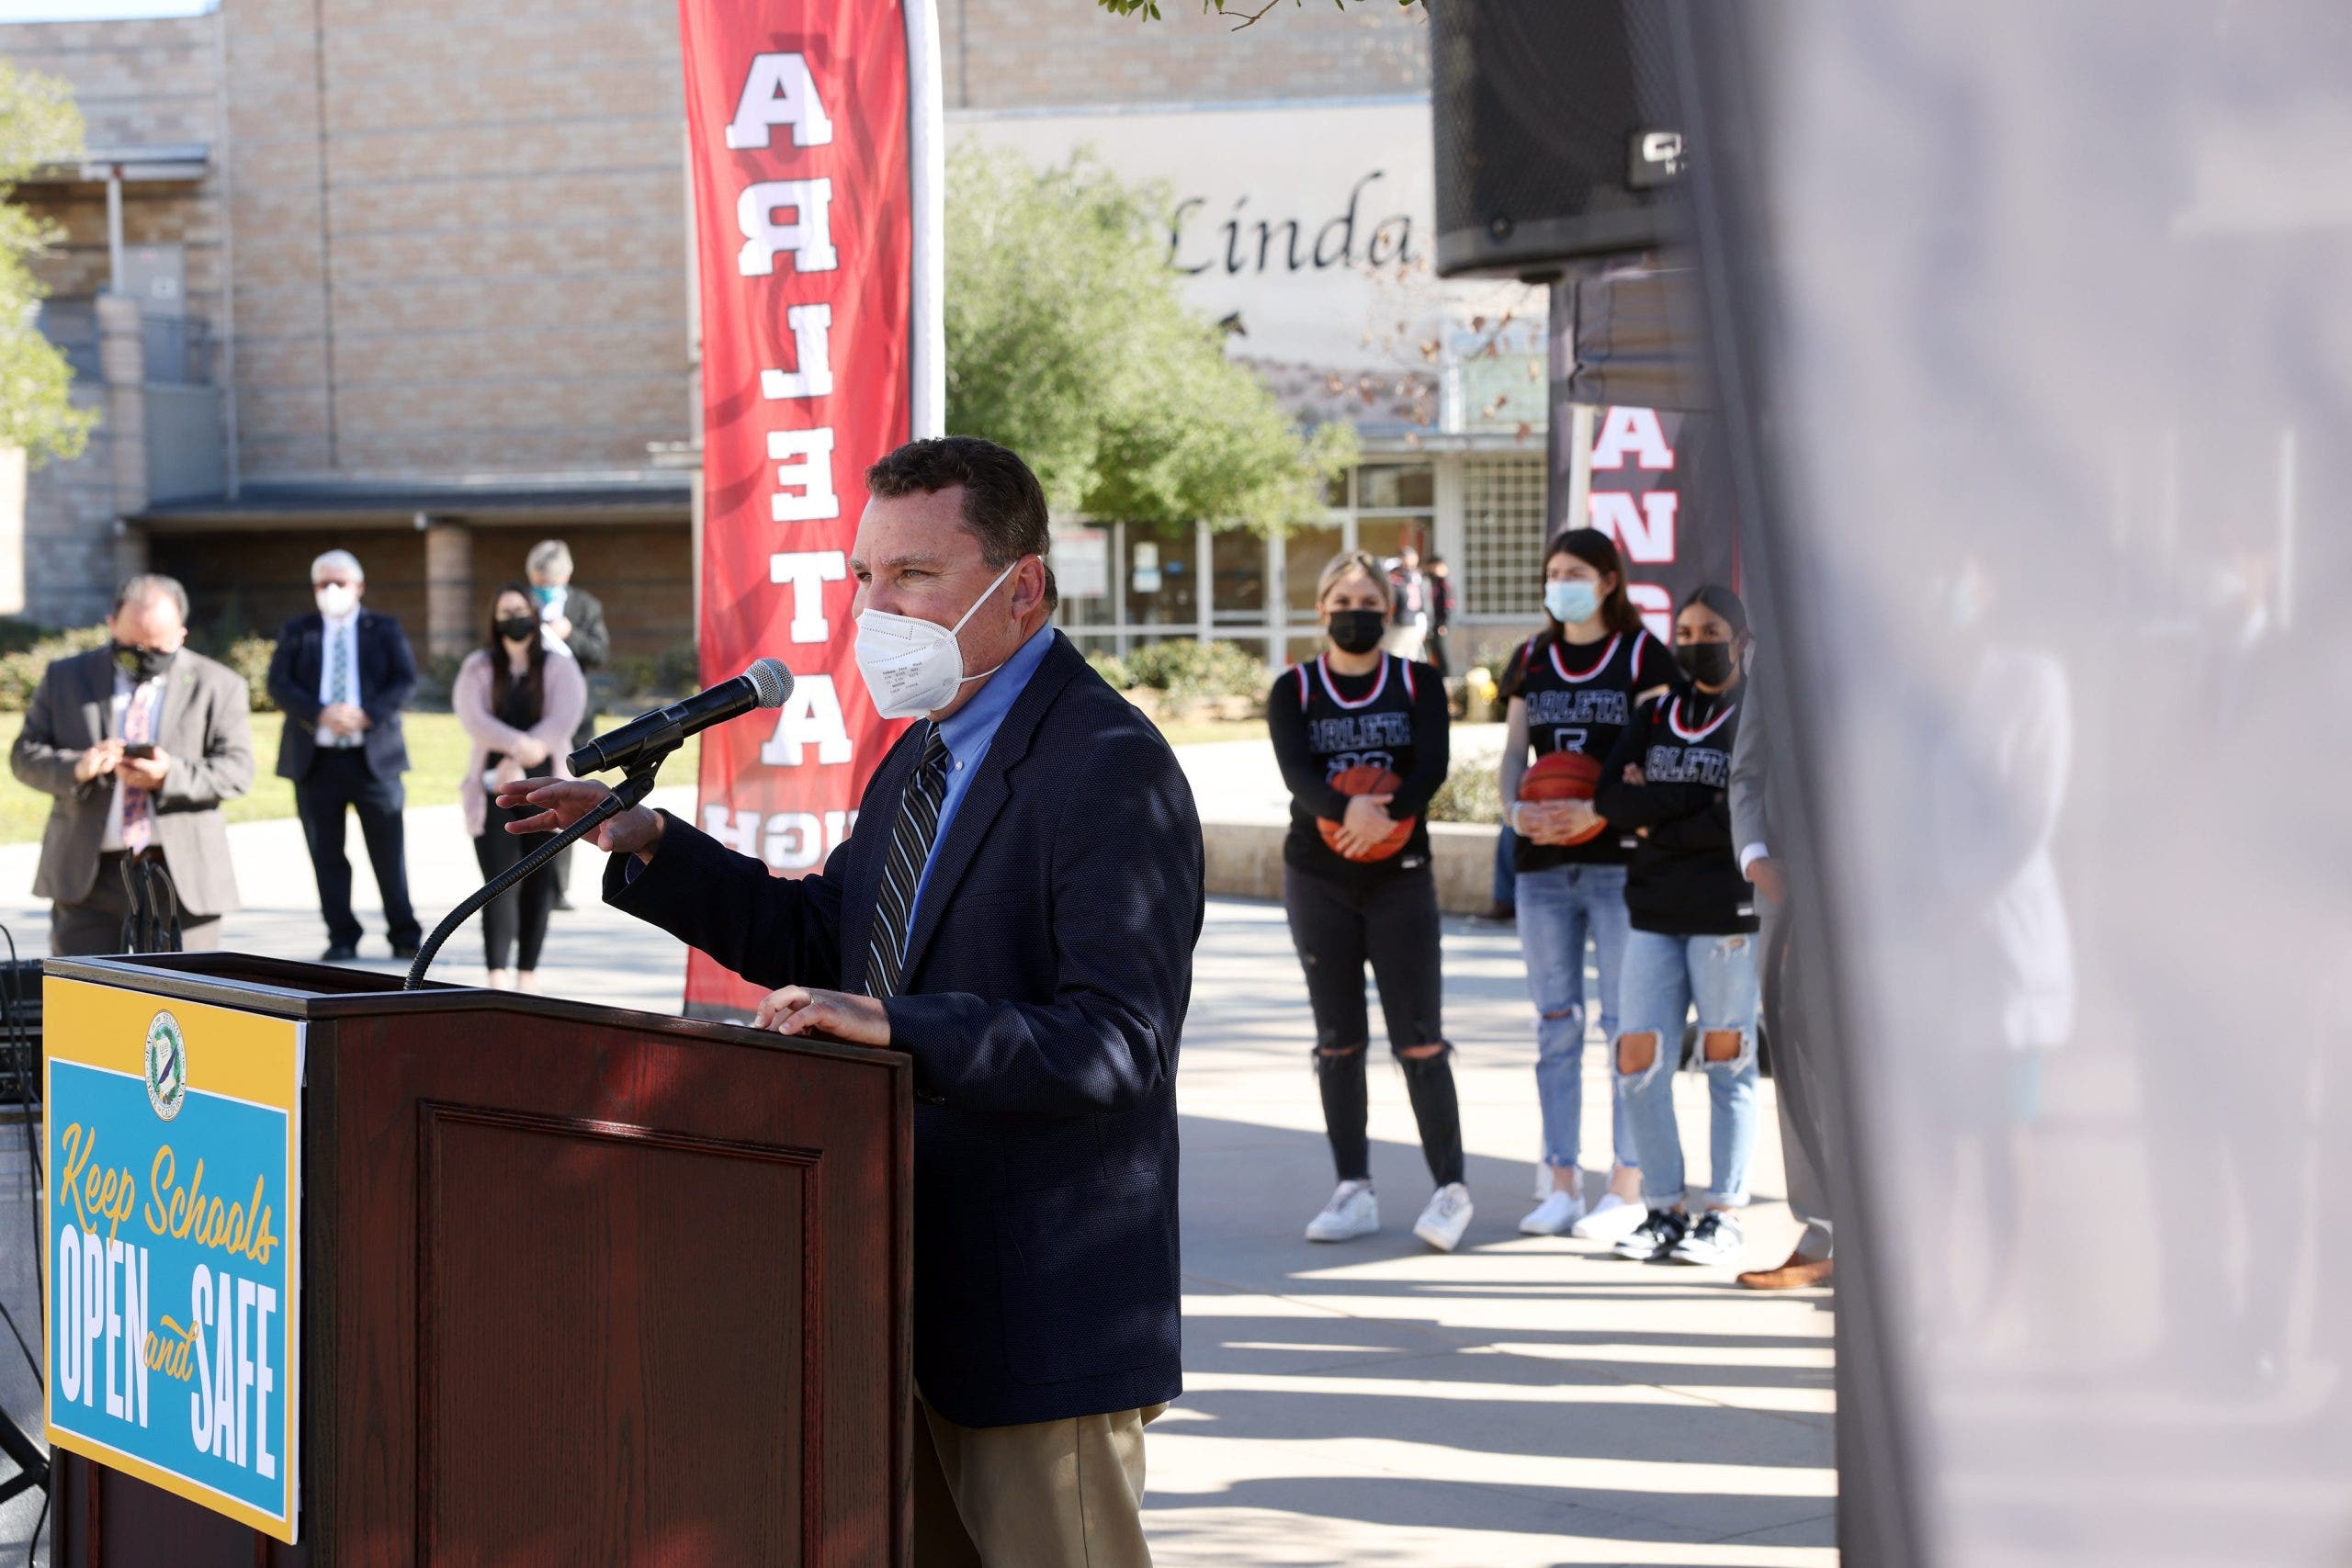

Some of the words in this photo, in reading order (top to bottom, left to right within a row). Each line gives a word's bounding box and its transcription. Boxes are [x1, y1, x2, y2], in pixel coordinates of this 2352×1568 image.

[1162, 169, 1419, 275] Linda
[1525, 690, 1630, 727] ARLETA
[60, 1122, 135, 1250] Keep
[144, 1145, 278, 1265] Schools
[59, 1224, 148, 1429] OPEN
[143, 1315, 198, 1382] and
[190, 1263, 277, 1481] SAFE
